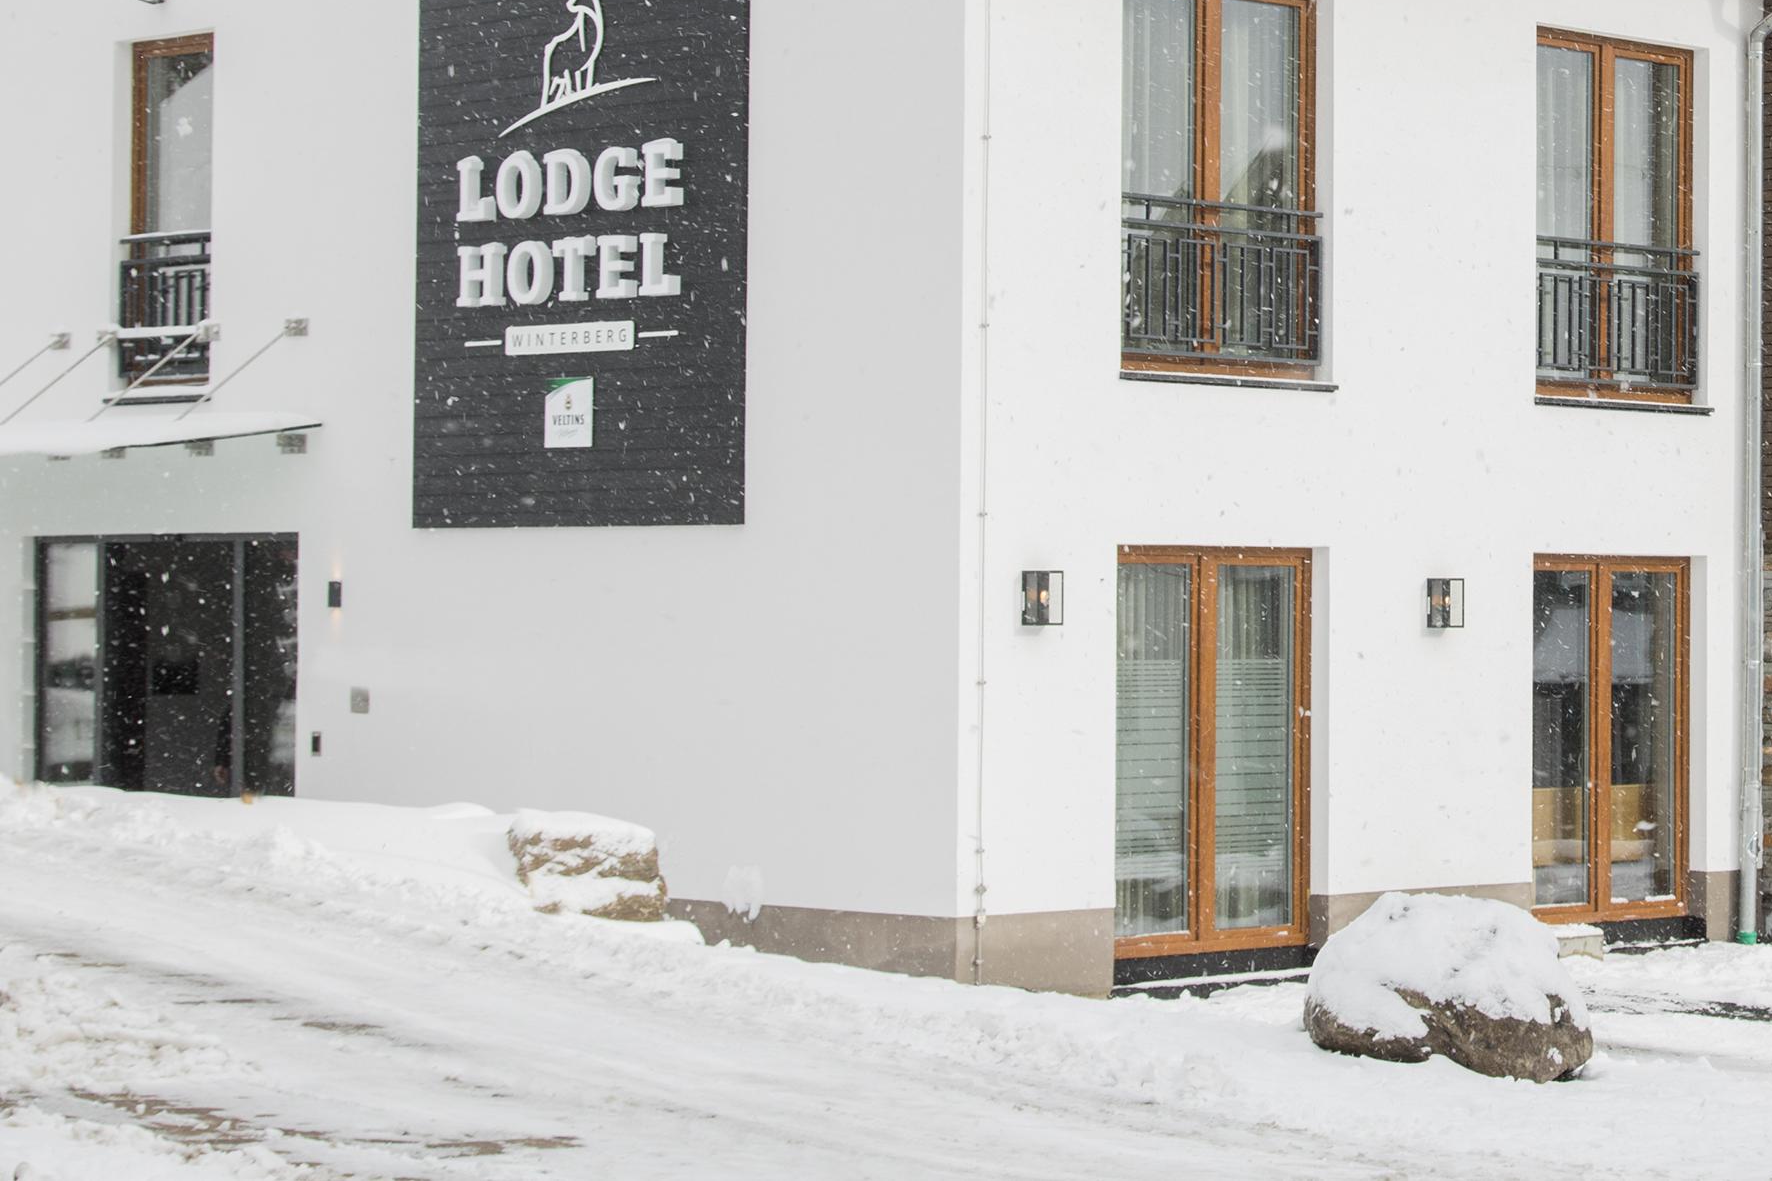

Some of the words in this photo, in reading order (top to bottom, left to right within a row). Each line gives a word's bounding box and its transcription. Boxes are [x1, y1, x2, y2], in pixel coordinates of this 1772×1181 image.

[456, 138, 684, 222] LODGE
[456, 233, 682, 307] HOTEL
[511, 327, 628, 348] WINTERBERG
[552, 414, 585, 426] VELTINS
